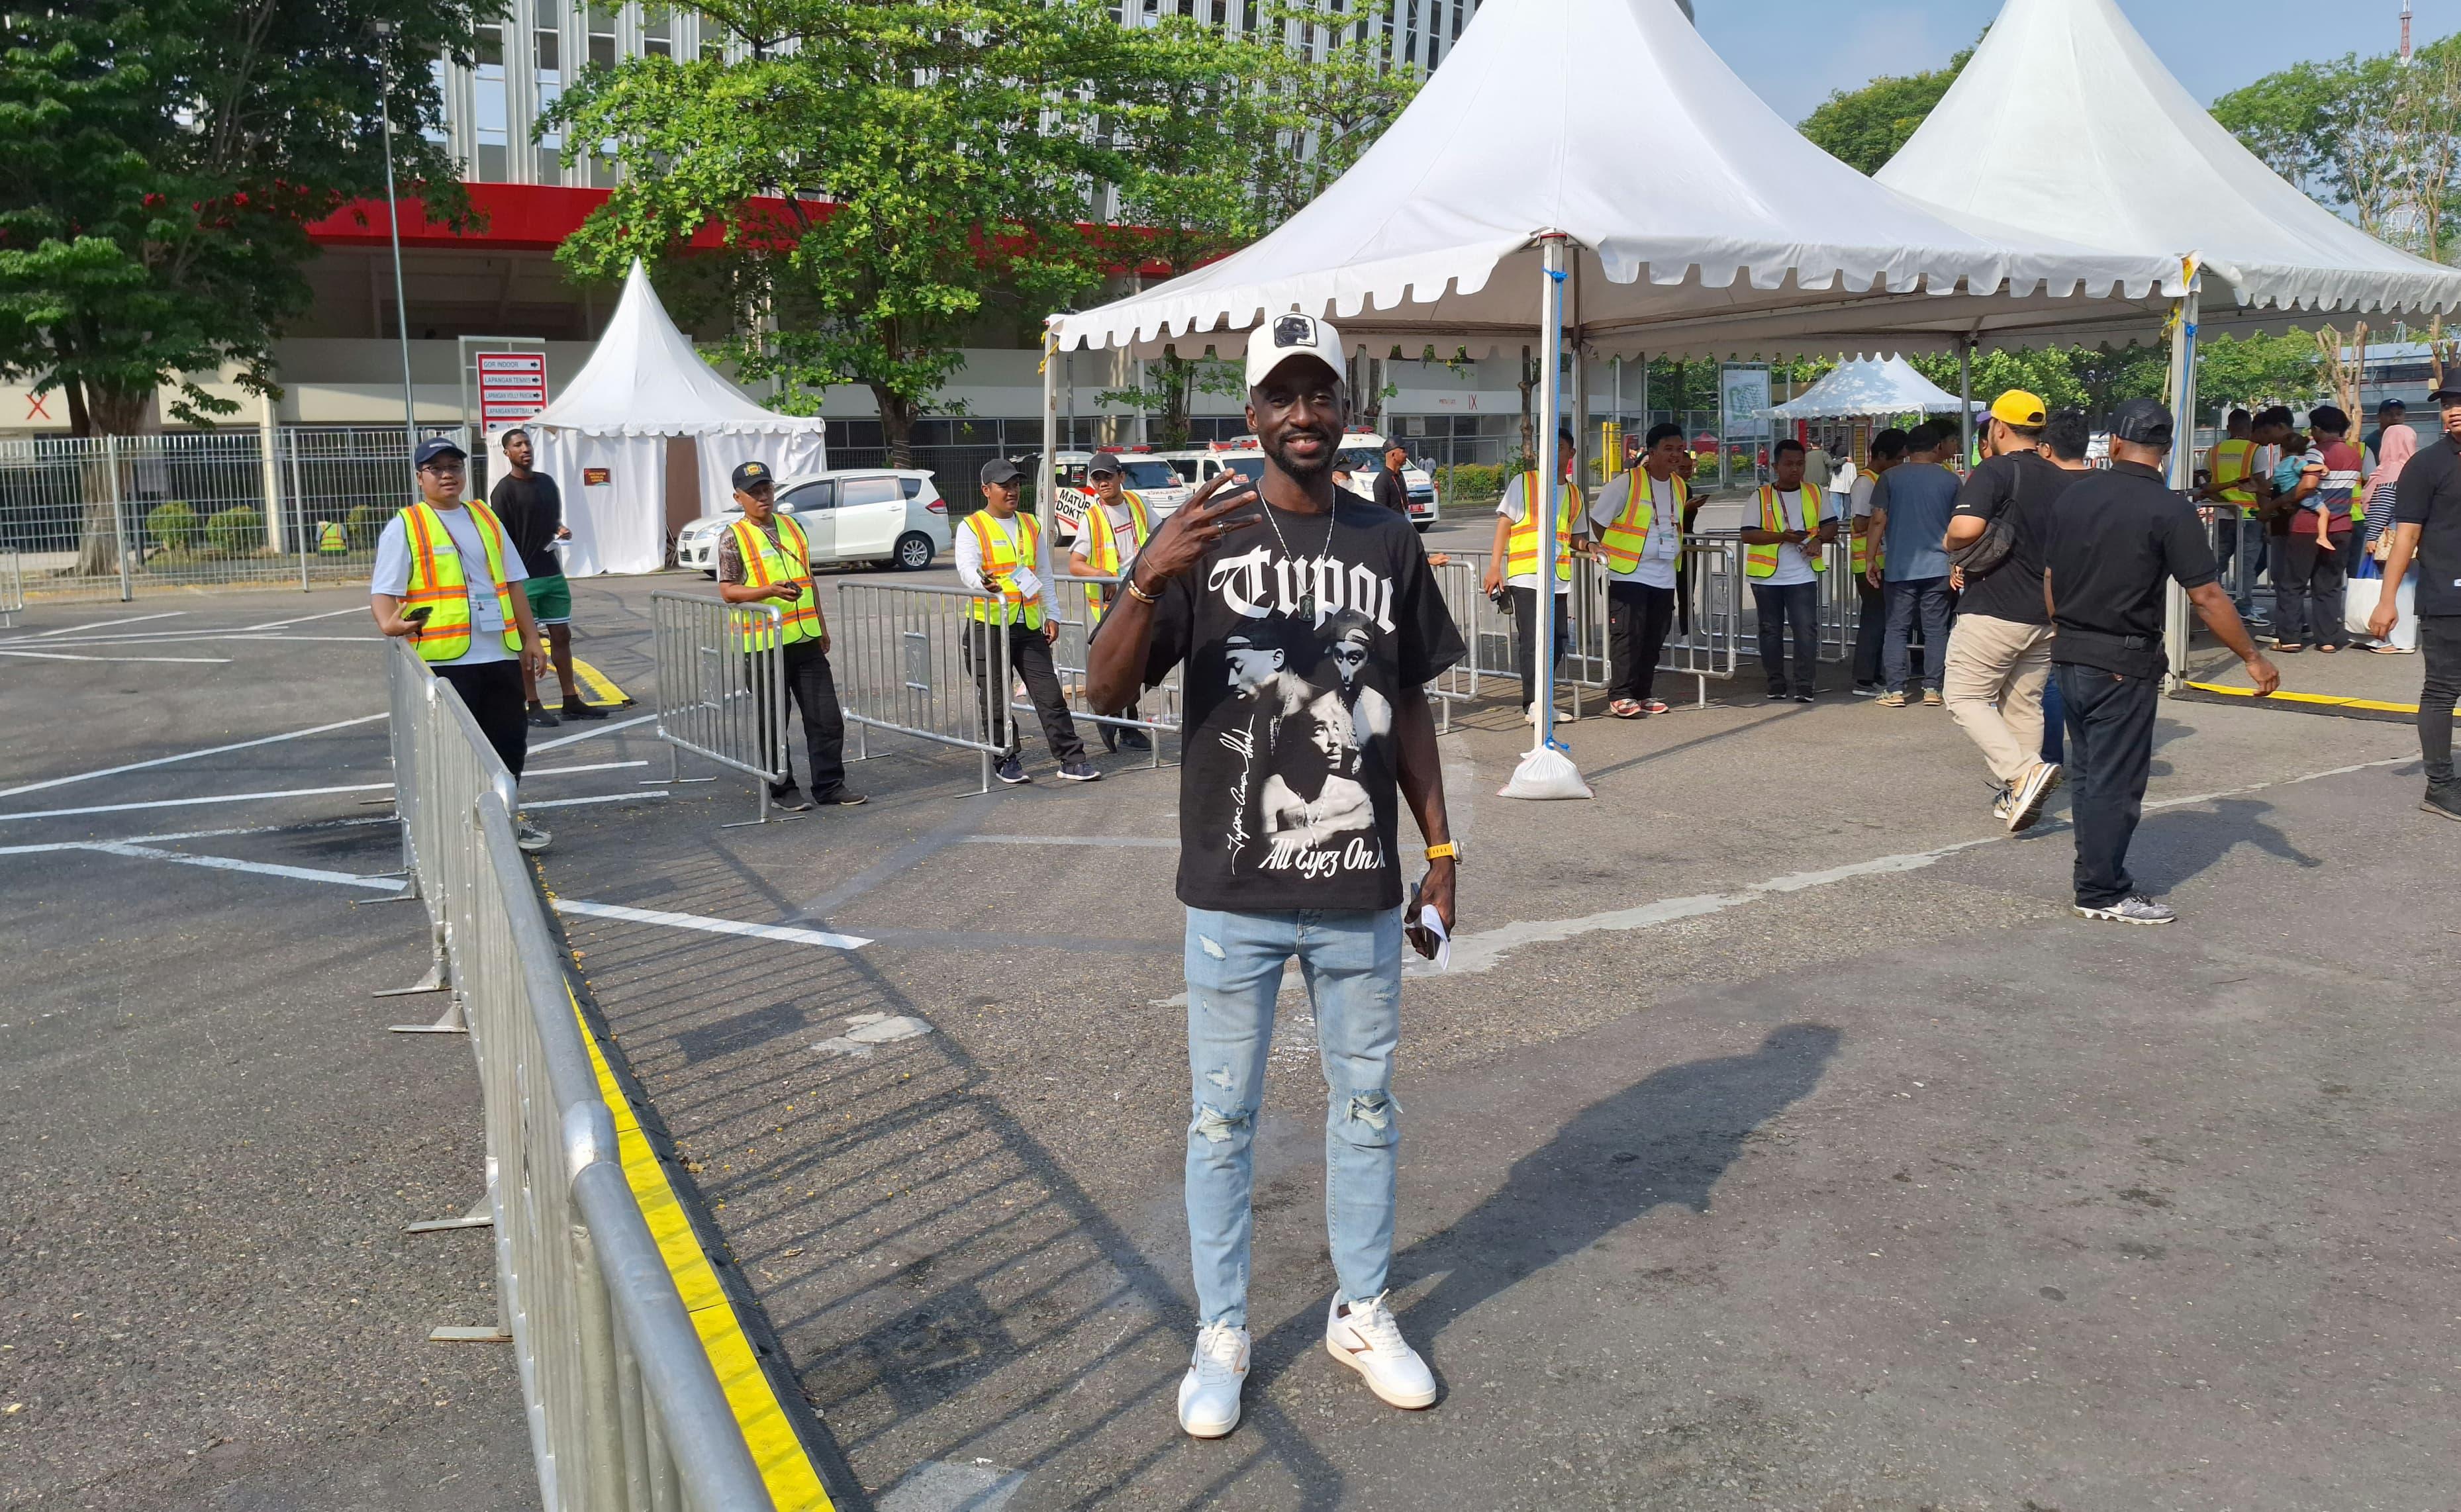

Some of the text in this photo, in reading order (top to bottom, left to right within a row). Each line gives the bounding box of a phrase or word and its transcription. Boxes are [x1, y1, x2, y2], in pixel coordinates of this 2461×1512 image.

[1468, 394, 1478, 410] IX
[1055, 500, 1082, 520] DOKT
[1258, 837, 1292, 870] All
[1295, 837, 1341, 879] Eyez
[1343, 837, 1375, 870] On
